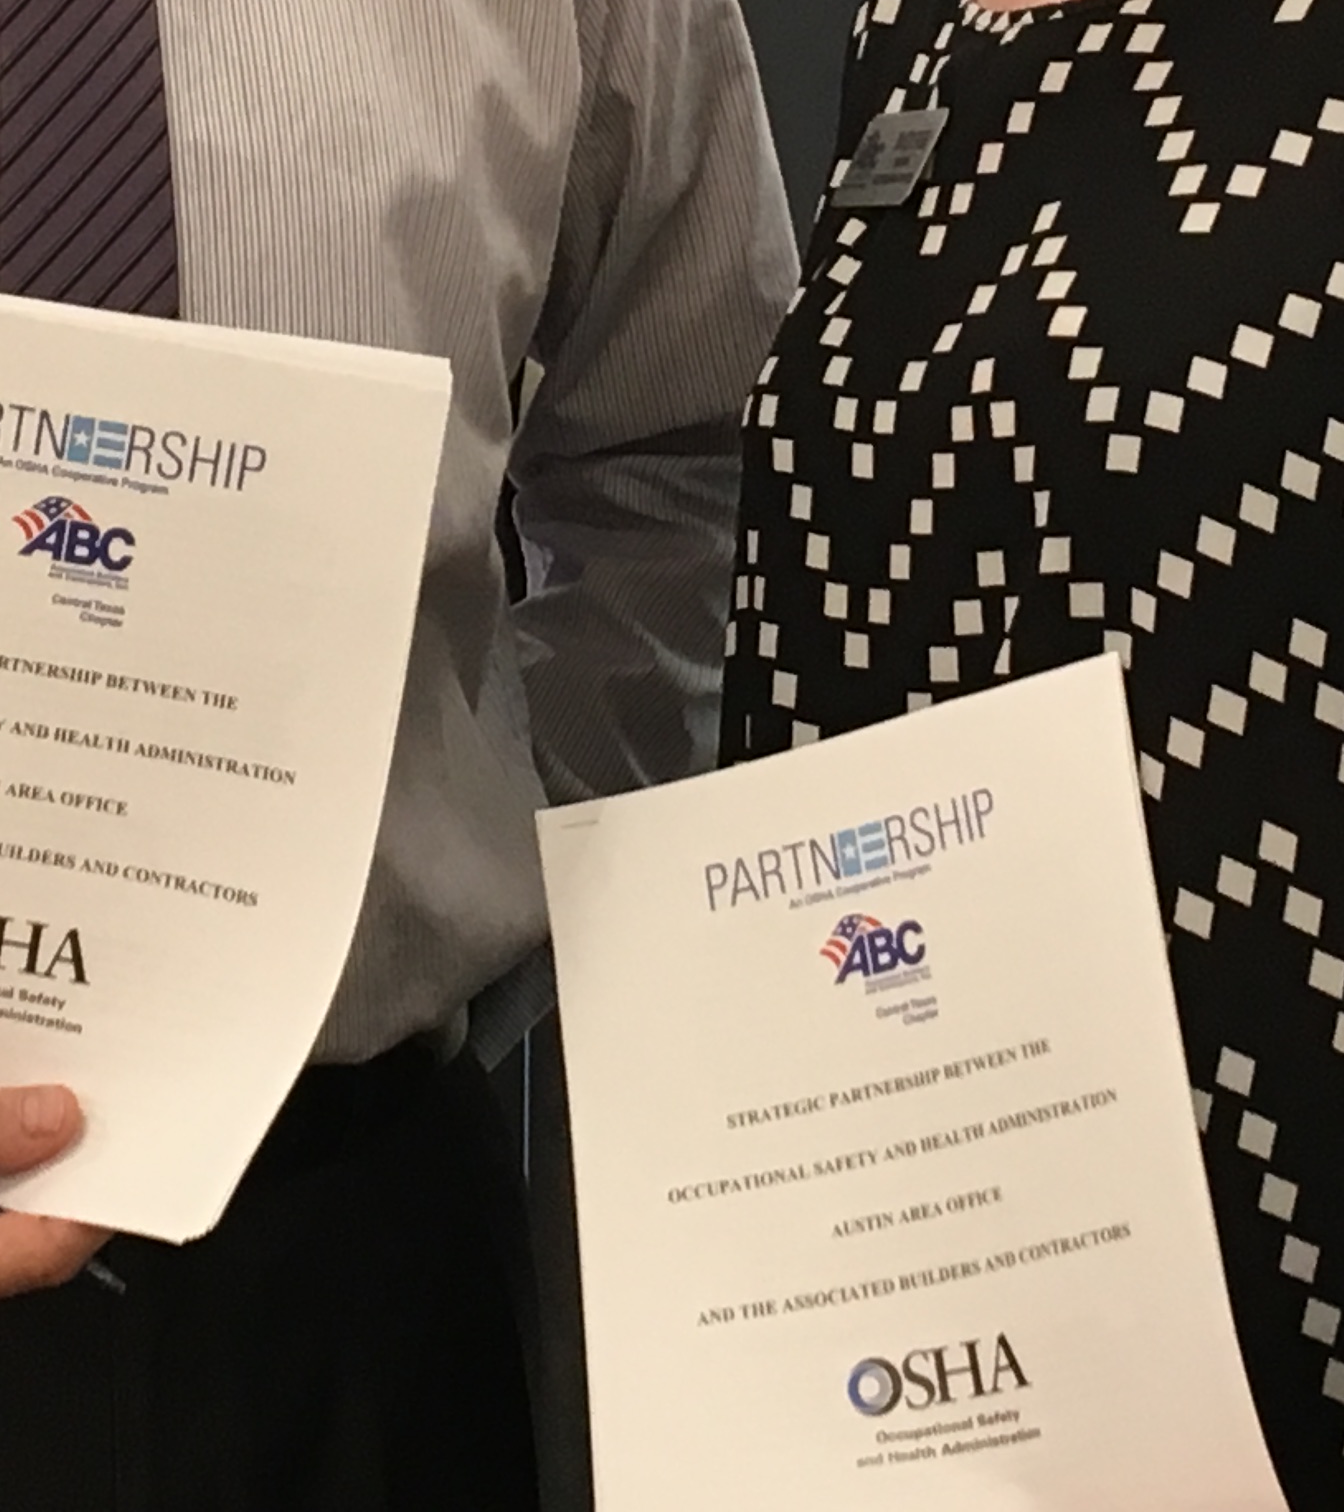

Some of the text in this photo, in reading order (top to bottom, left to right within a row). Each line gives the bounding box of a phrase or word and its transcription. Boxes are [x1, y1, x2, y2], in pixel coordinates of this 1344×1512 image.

[52, 465, 118, 488] Cooperative
[121, 476, 168, 495] Program
[18, 519, 136, 571] ABC
[106, 673, 196, 703] BETWEEN
[201, 690, 239, 710] THE
[10, 720, 50, 740] AND
[54, 726, 130, 754] HEALTH
[134, 742, 297, 786] ADMINISTRATION
[5, 783, 56, 804] AREA
[60, 790, 129, 817] OFFICE
[705, 788, 994, 912] PARTNERSHIP
[79, 857, 119, 878] AND
[122, 864, 258, 907] CONTRACTORS
[835, 920, 926, 986] ABC
[18, 989, 67, 1011] Safety
[726, 1038, 1051, 1129] STRATEGIC PARTNERSHIP BETWEEN THE
[667, 1087, 1118, 1204] OCCUPATIONAL SAFETY AND HEALTH ADMINISTRATION
[832, 1185, 1003, 1239] AUSTIN AREA OFFICE
[697, 1221, 1132, 1327] AND THE ASSOCIATED BUILDERS AND CONTRACTORS
[848, 1331, 1033, 1418] OSHA
[856, 1427, 1042, 1468] and Health Administration
[875, 1409, 1021, 1444] Occupational Safety
